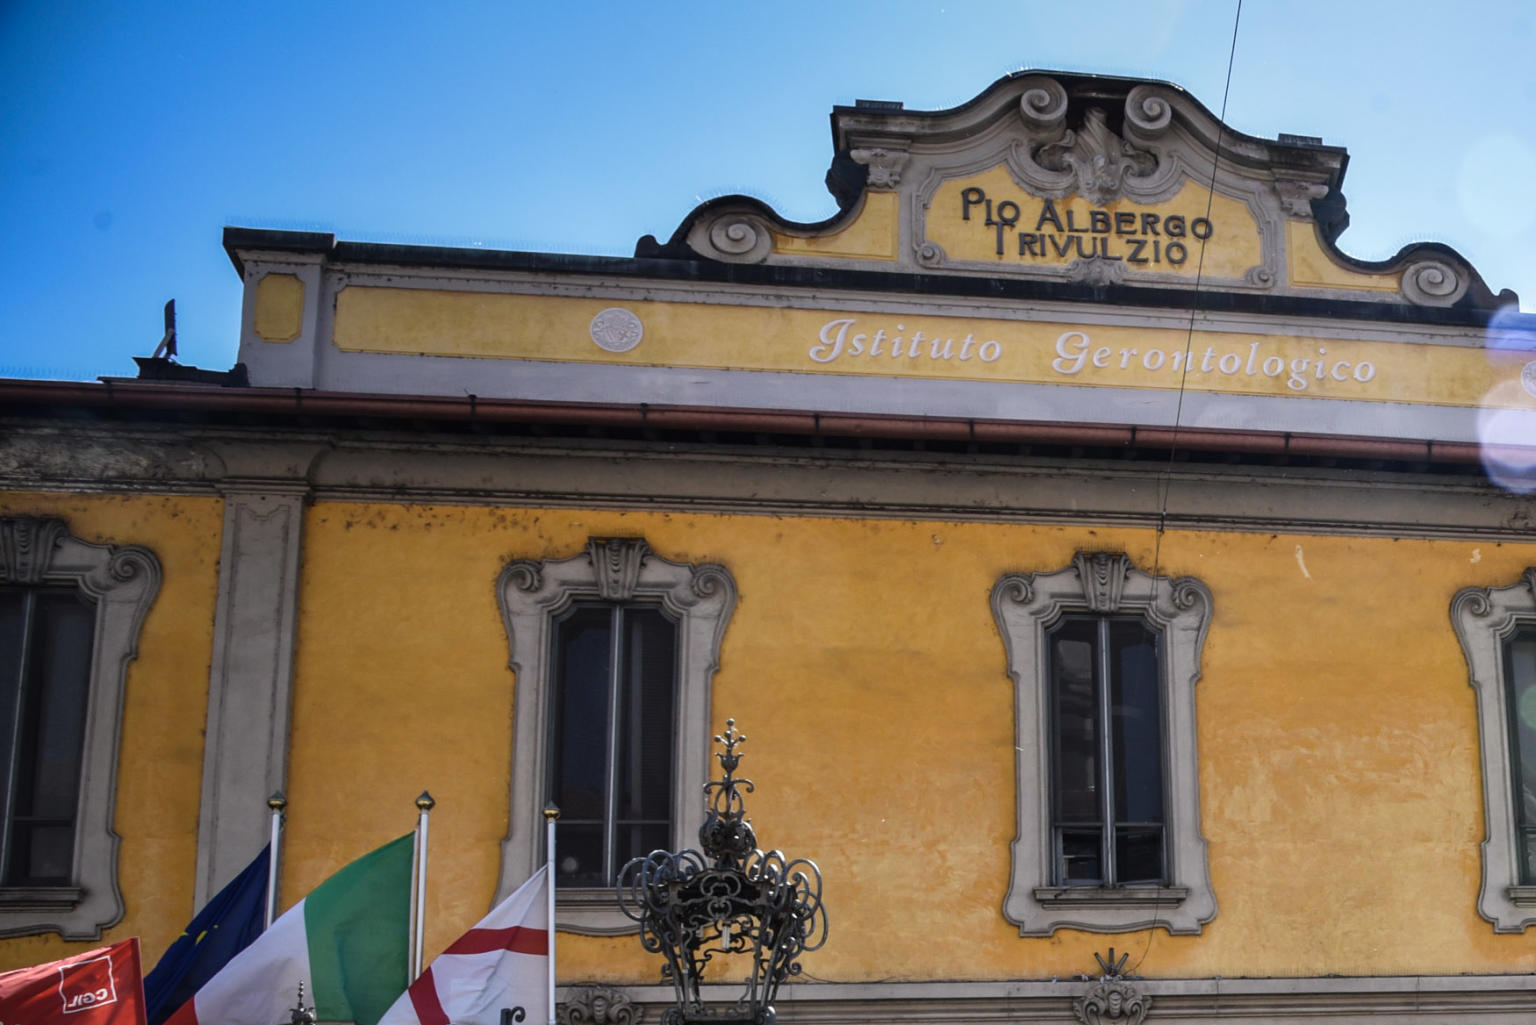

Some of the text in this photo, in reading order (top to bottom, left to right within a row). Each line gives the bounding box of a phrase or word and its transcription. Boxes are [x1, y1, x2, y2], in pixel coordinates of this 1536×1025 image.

[1039, 199, 1214, 240] ALBERGO
[996, 222, 1189, 264] TRIVULZIO
[808, 319, 1376, 390] Istituto Gerontologico
